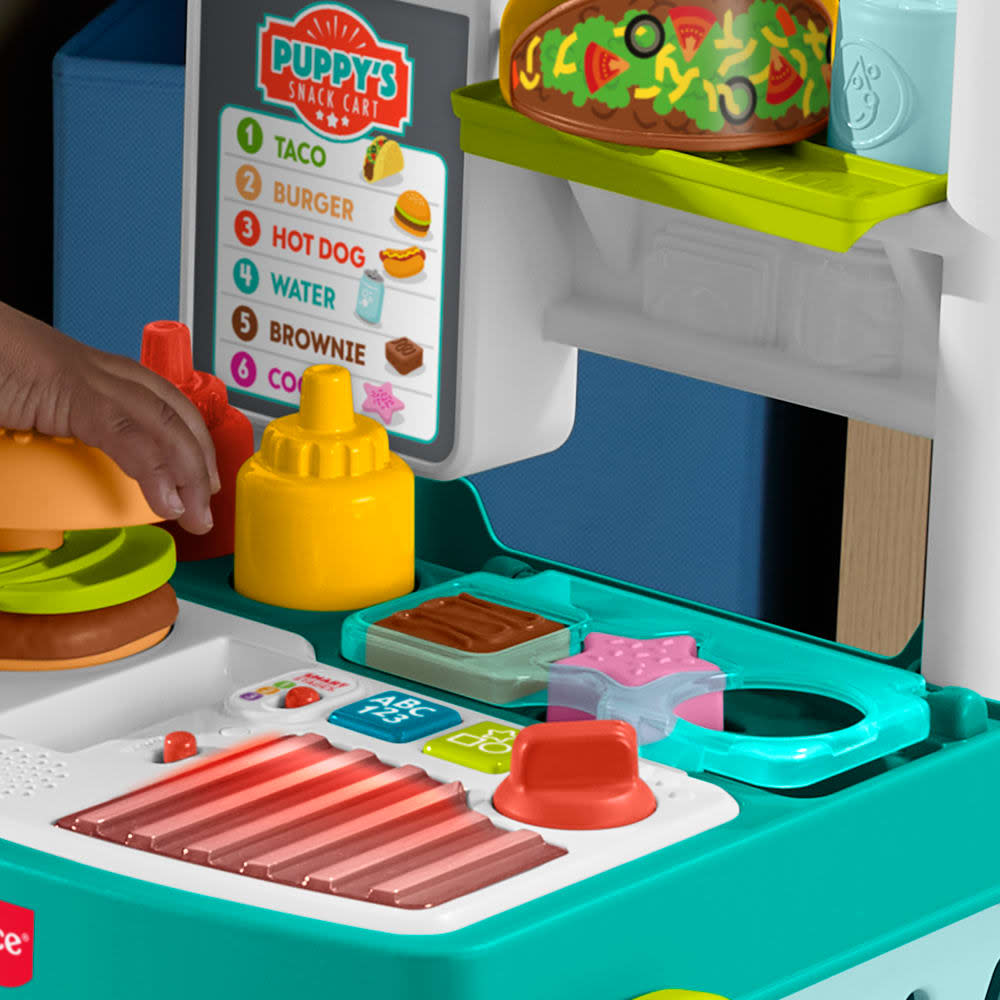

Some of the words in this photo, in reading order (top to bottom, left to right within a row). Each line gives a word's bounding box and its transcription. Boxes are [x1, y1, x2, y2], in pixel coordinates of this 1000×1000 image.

[271, 36, 397, 99] PUPPY'S
[289, 80, 335, 109] SNACK
[343, 94, 379, 118] CART
[274, 135, 327, 168] TACO
[273, 181, 354, 222] BURGER
[272, 225, 315, 256] HOT
[319, 236, 366, 268] DOG
[270, 271, 336, 311] WATER
[269, 321, 366, 366] BROWNIE
[357, 705, 409, 724] 123
[369, 695, 437, 717] ABC
